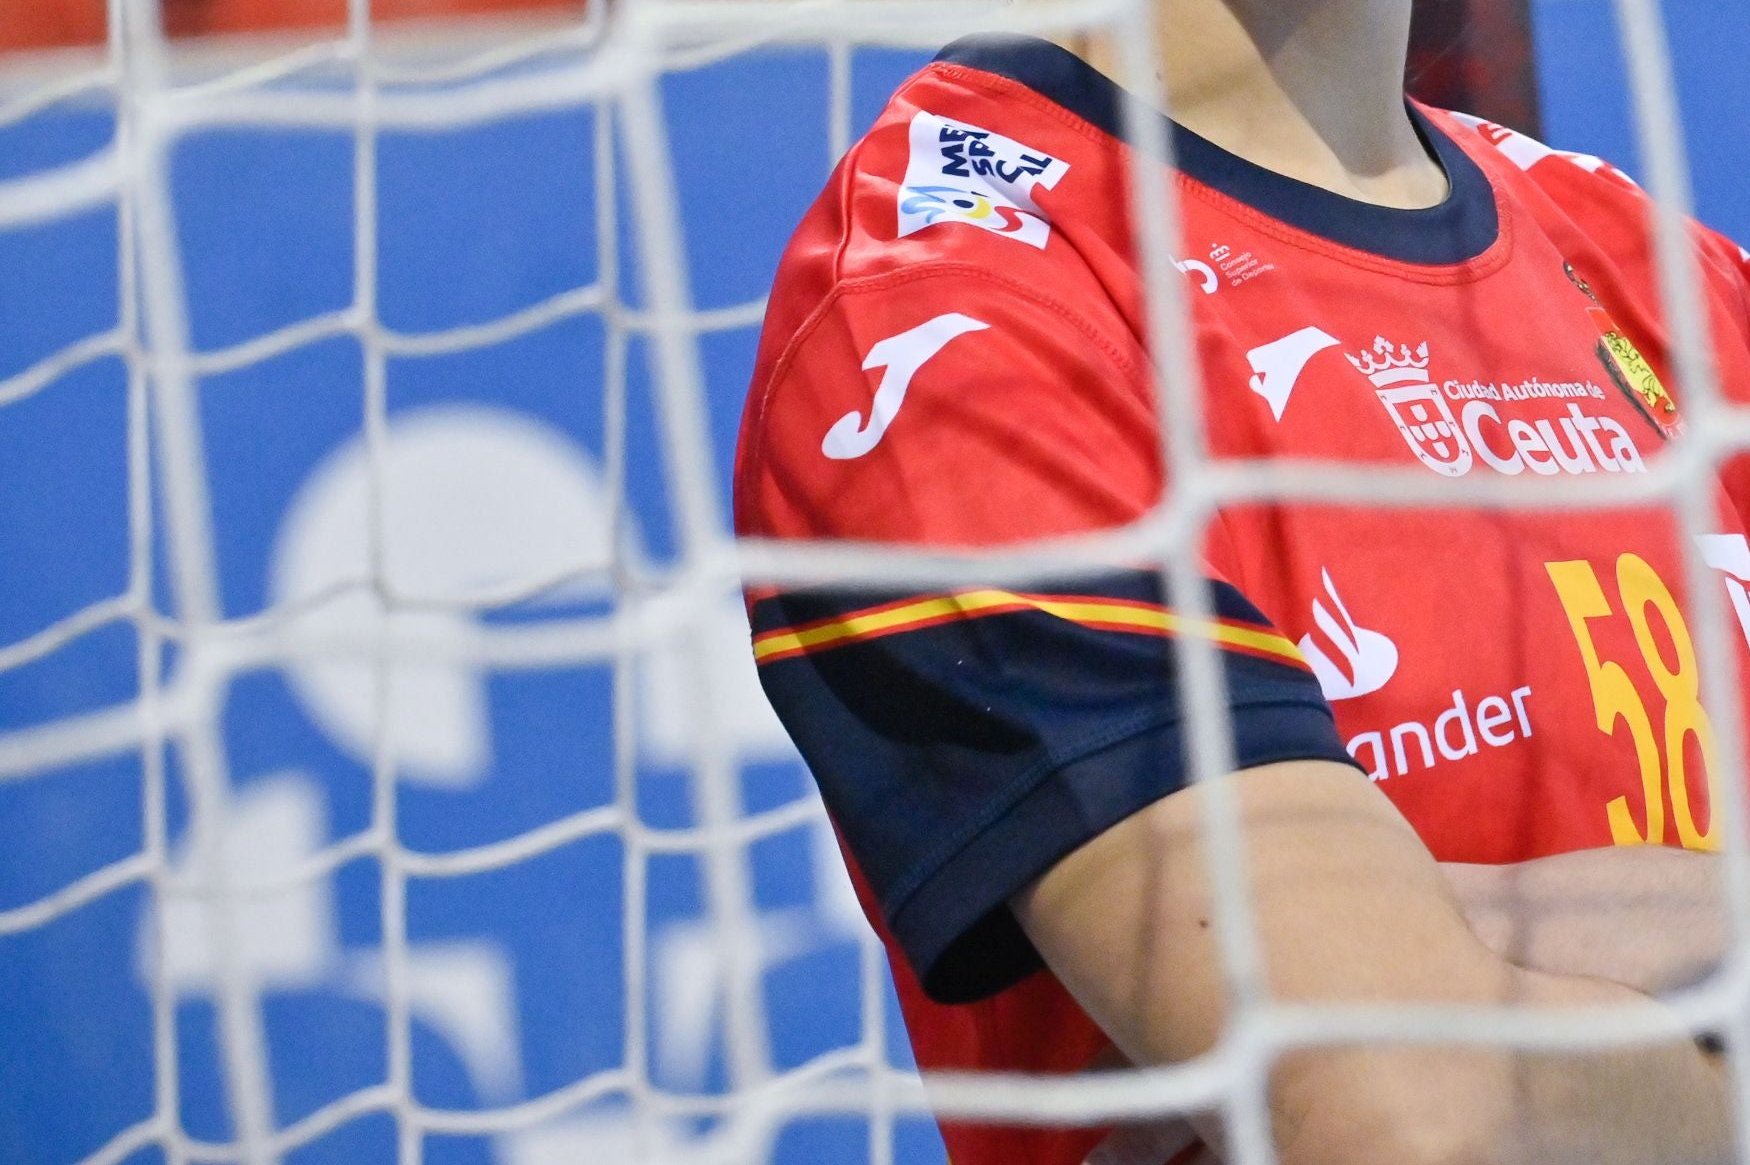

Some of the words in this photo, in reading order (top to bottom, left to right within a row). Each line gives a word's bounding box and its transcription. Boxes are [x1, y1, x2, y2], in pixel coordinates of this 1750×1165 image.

[1443, 379, 1502, 401] Ciudad
[1502, 376, 1588, 402] Autónoma
[1588, 382, 1606, 400] de
[1461, 400, 1648, 476] Ceuta
[1345, 685, 1534, 783] ander
[1544, 552, 1720, 852] 58
